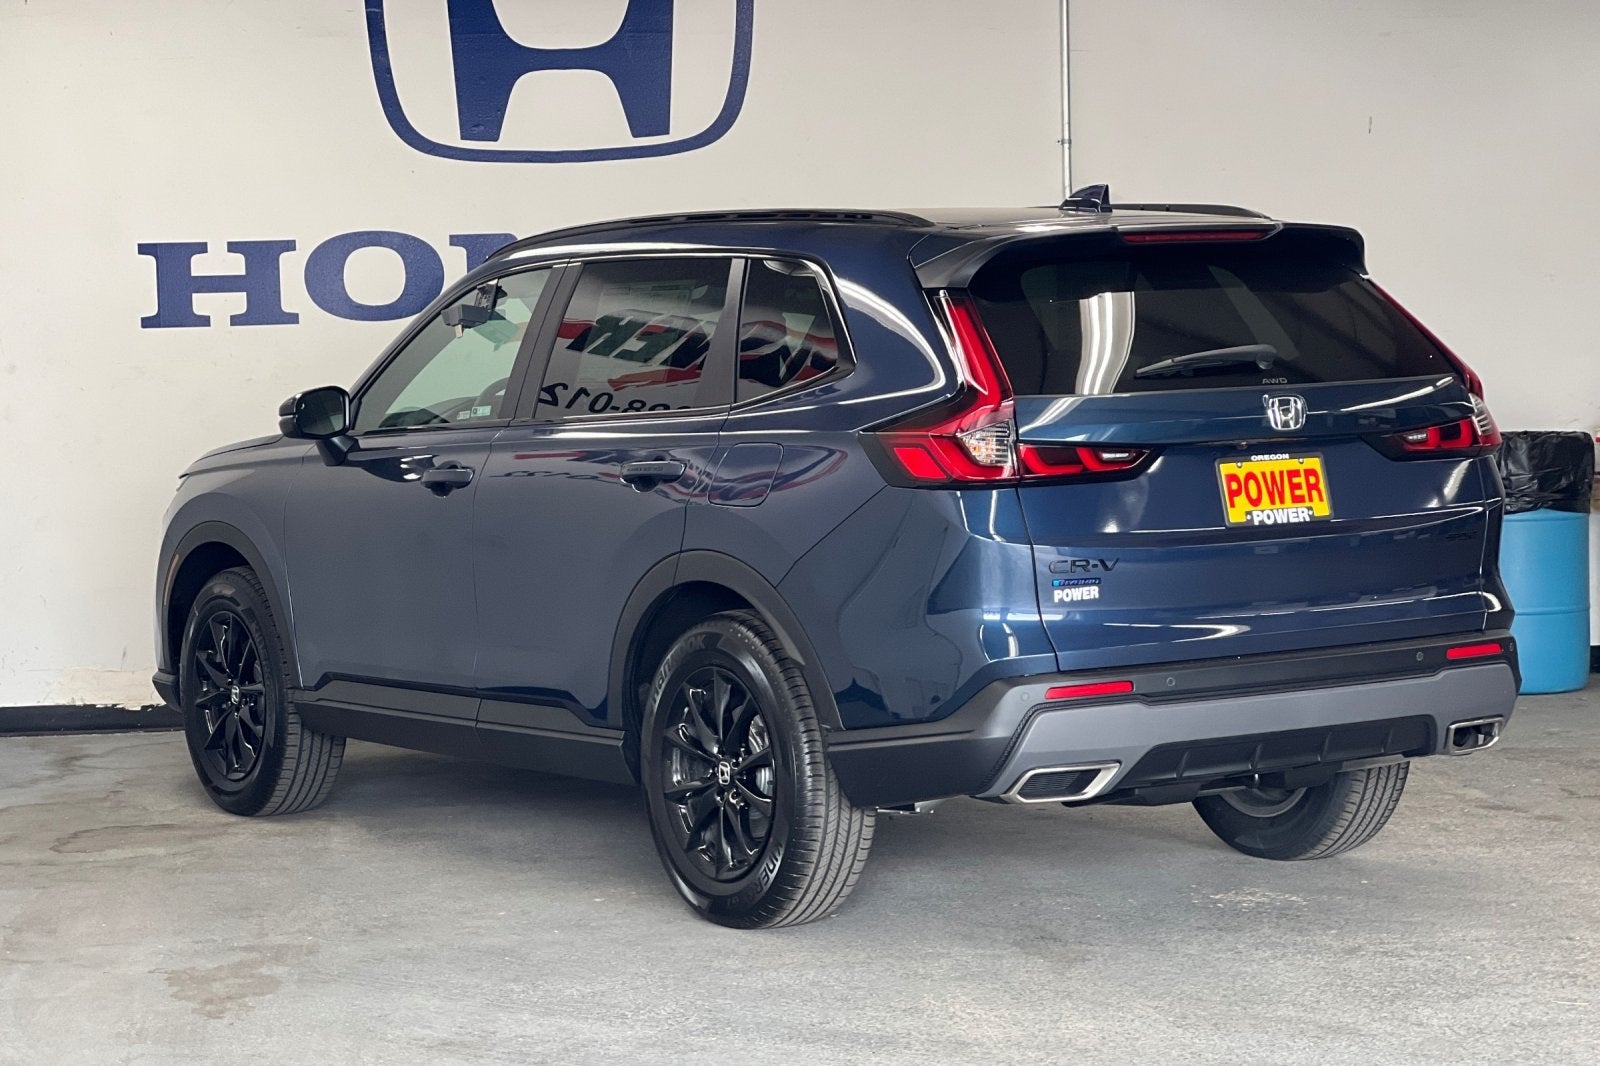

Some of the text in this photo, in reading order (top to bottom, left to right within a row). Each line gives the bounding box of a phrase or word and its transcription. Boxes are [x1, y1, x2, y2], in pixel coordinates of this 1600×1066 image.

[1262, 377, 1288, 385] AWD
[1250, 453, 1290, 461] OREGON
[1224, 468, 1325, 509] POWER
[1252, 507, 1311, 526] POWER
[1049, 558, 1120, 574] CR-V
[1053, 586, 1100, 603] POWER
